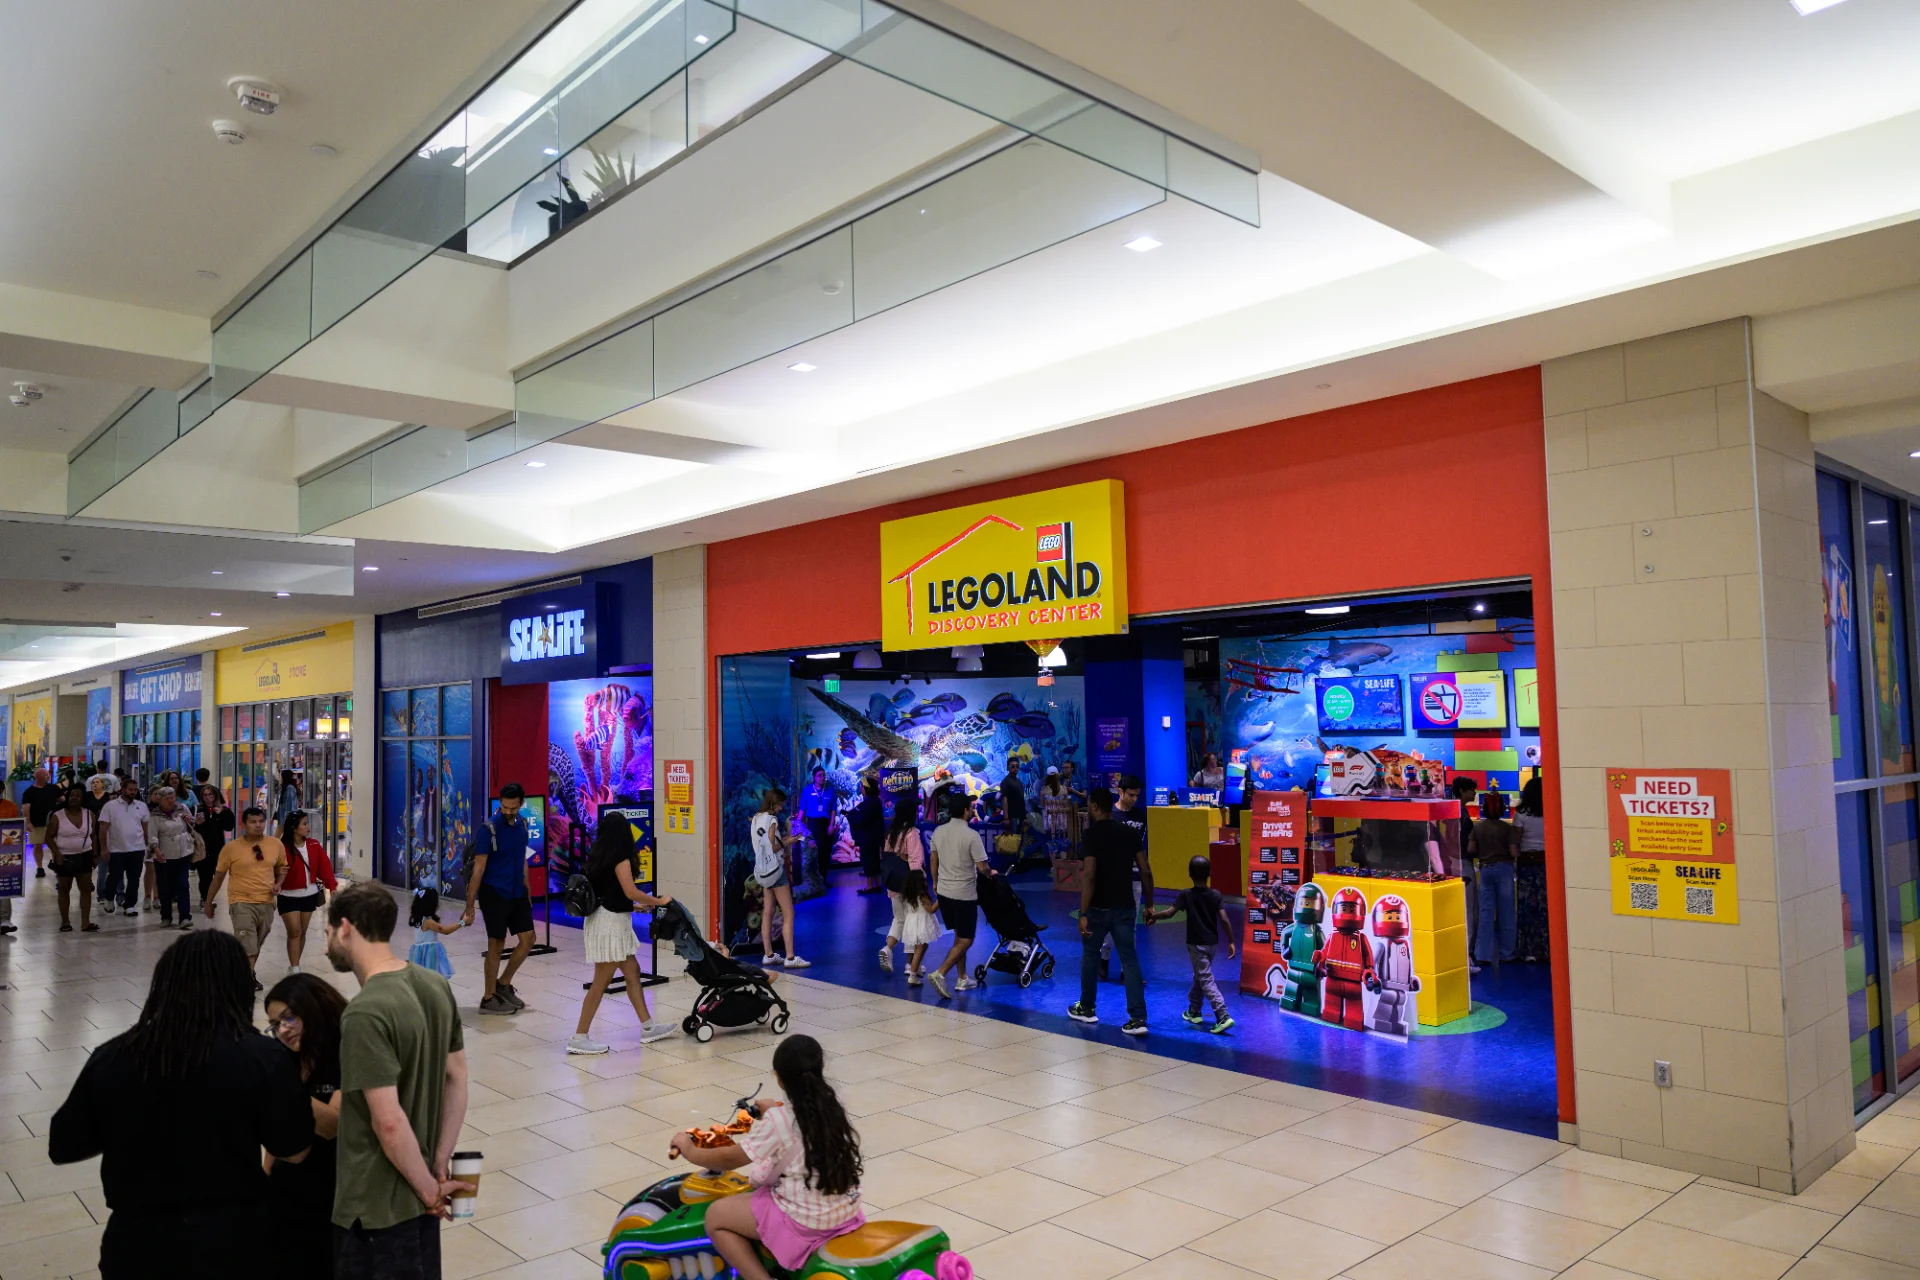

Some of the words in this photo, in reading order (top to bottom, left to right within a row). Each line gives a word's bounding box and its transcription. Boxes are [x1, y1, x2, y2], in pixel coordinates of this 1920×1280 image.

[252, 90, 271, 99] FIRE
[1038, 534, 1061, 550] LEGO
[928, 521, 1102, 614] LEGOLAND
[927, 610, 1021, 635] DISCOVERY
[1028, 602, 1102, 625] CENTER
[289, 664, 306, 677] STORE
[141, 676, 157, 704] GIFT
[158, 672, 181, 702] SHOP
[1644, 781, 1691, 795] NEED
[1629, 800, 1709, 815] TICKETS?
[1263, 822, 1292, 830] Drivers'
[1631, 864, 1660, 873] LEGOLAND
[1675, 865, 1697, 878] SEA
